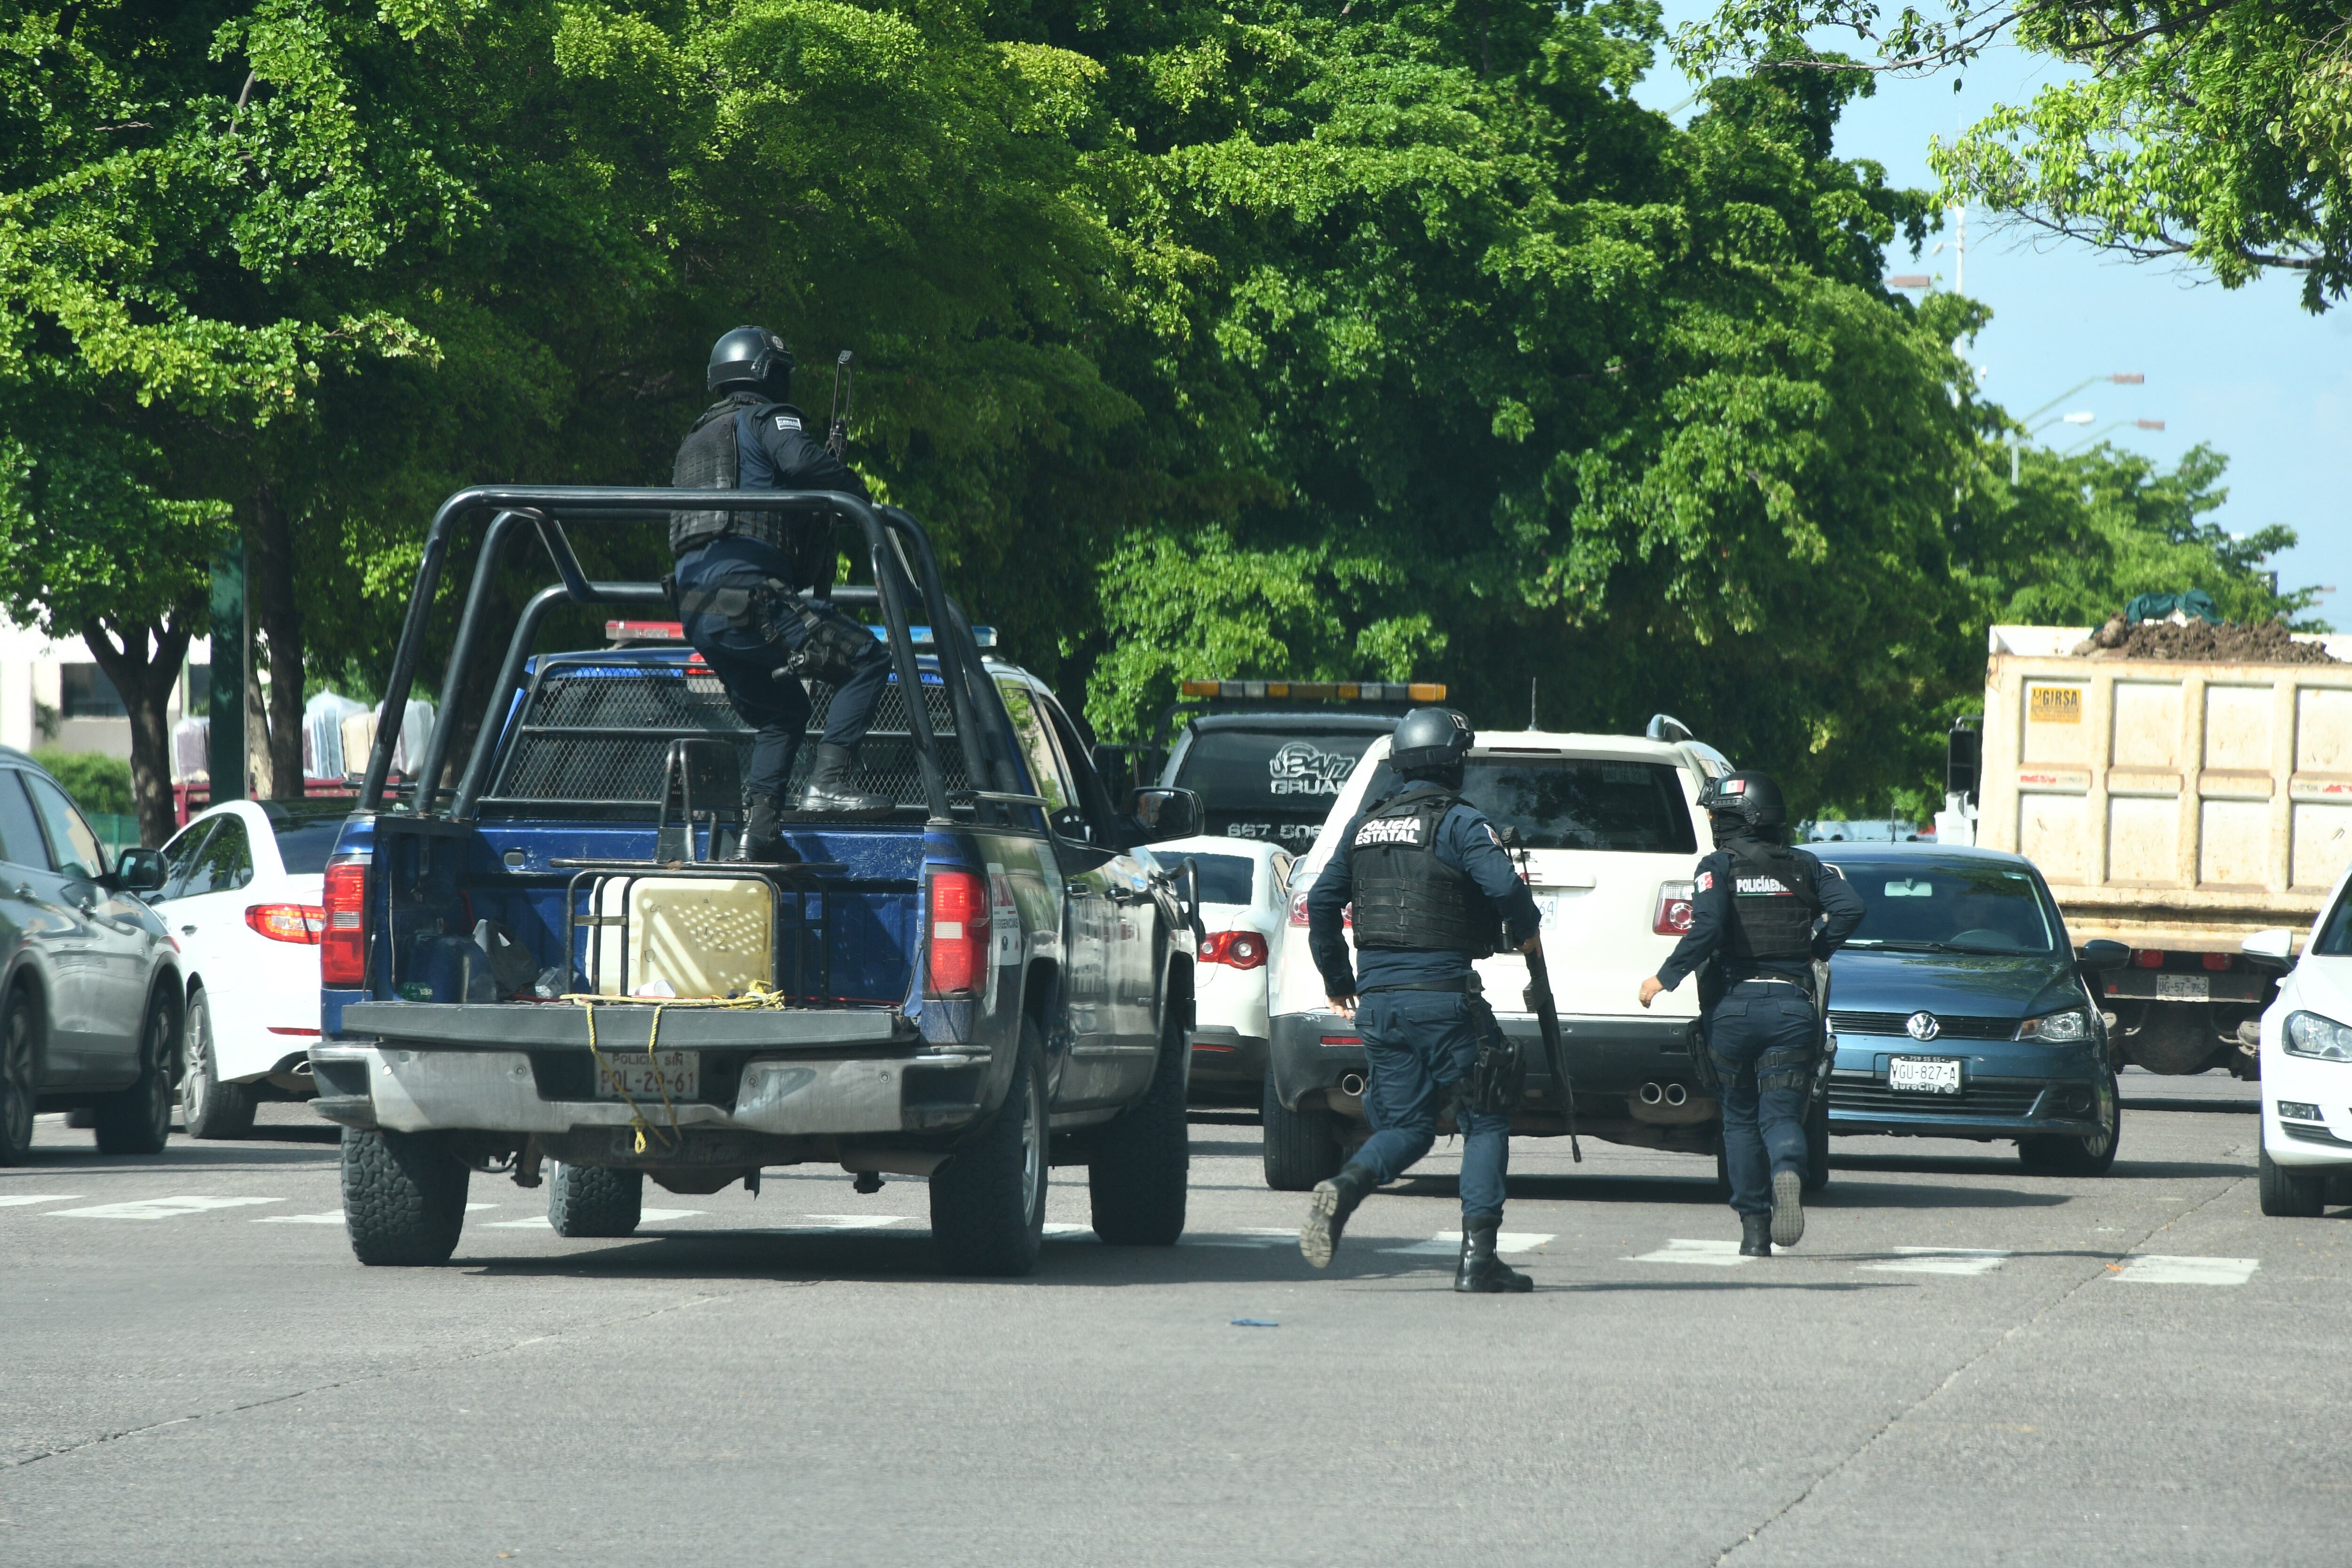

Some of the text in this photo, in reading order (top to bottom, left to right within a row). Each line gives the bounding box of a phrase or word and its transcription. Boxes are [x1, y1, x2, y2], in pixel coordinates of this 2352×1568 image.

[2043, 690, 2077, 706] GIRSA
[1355, 829, 1418, 845] ESTATAL
[1893, 1082, 1940, 1093] EuroCity
